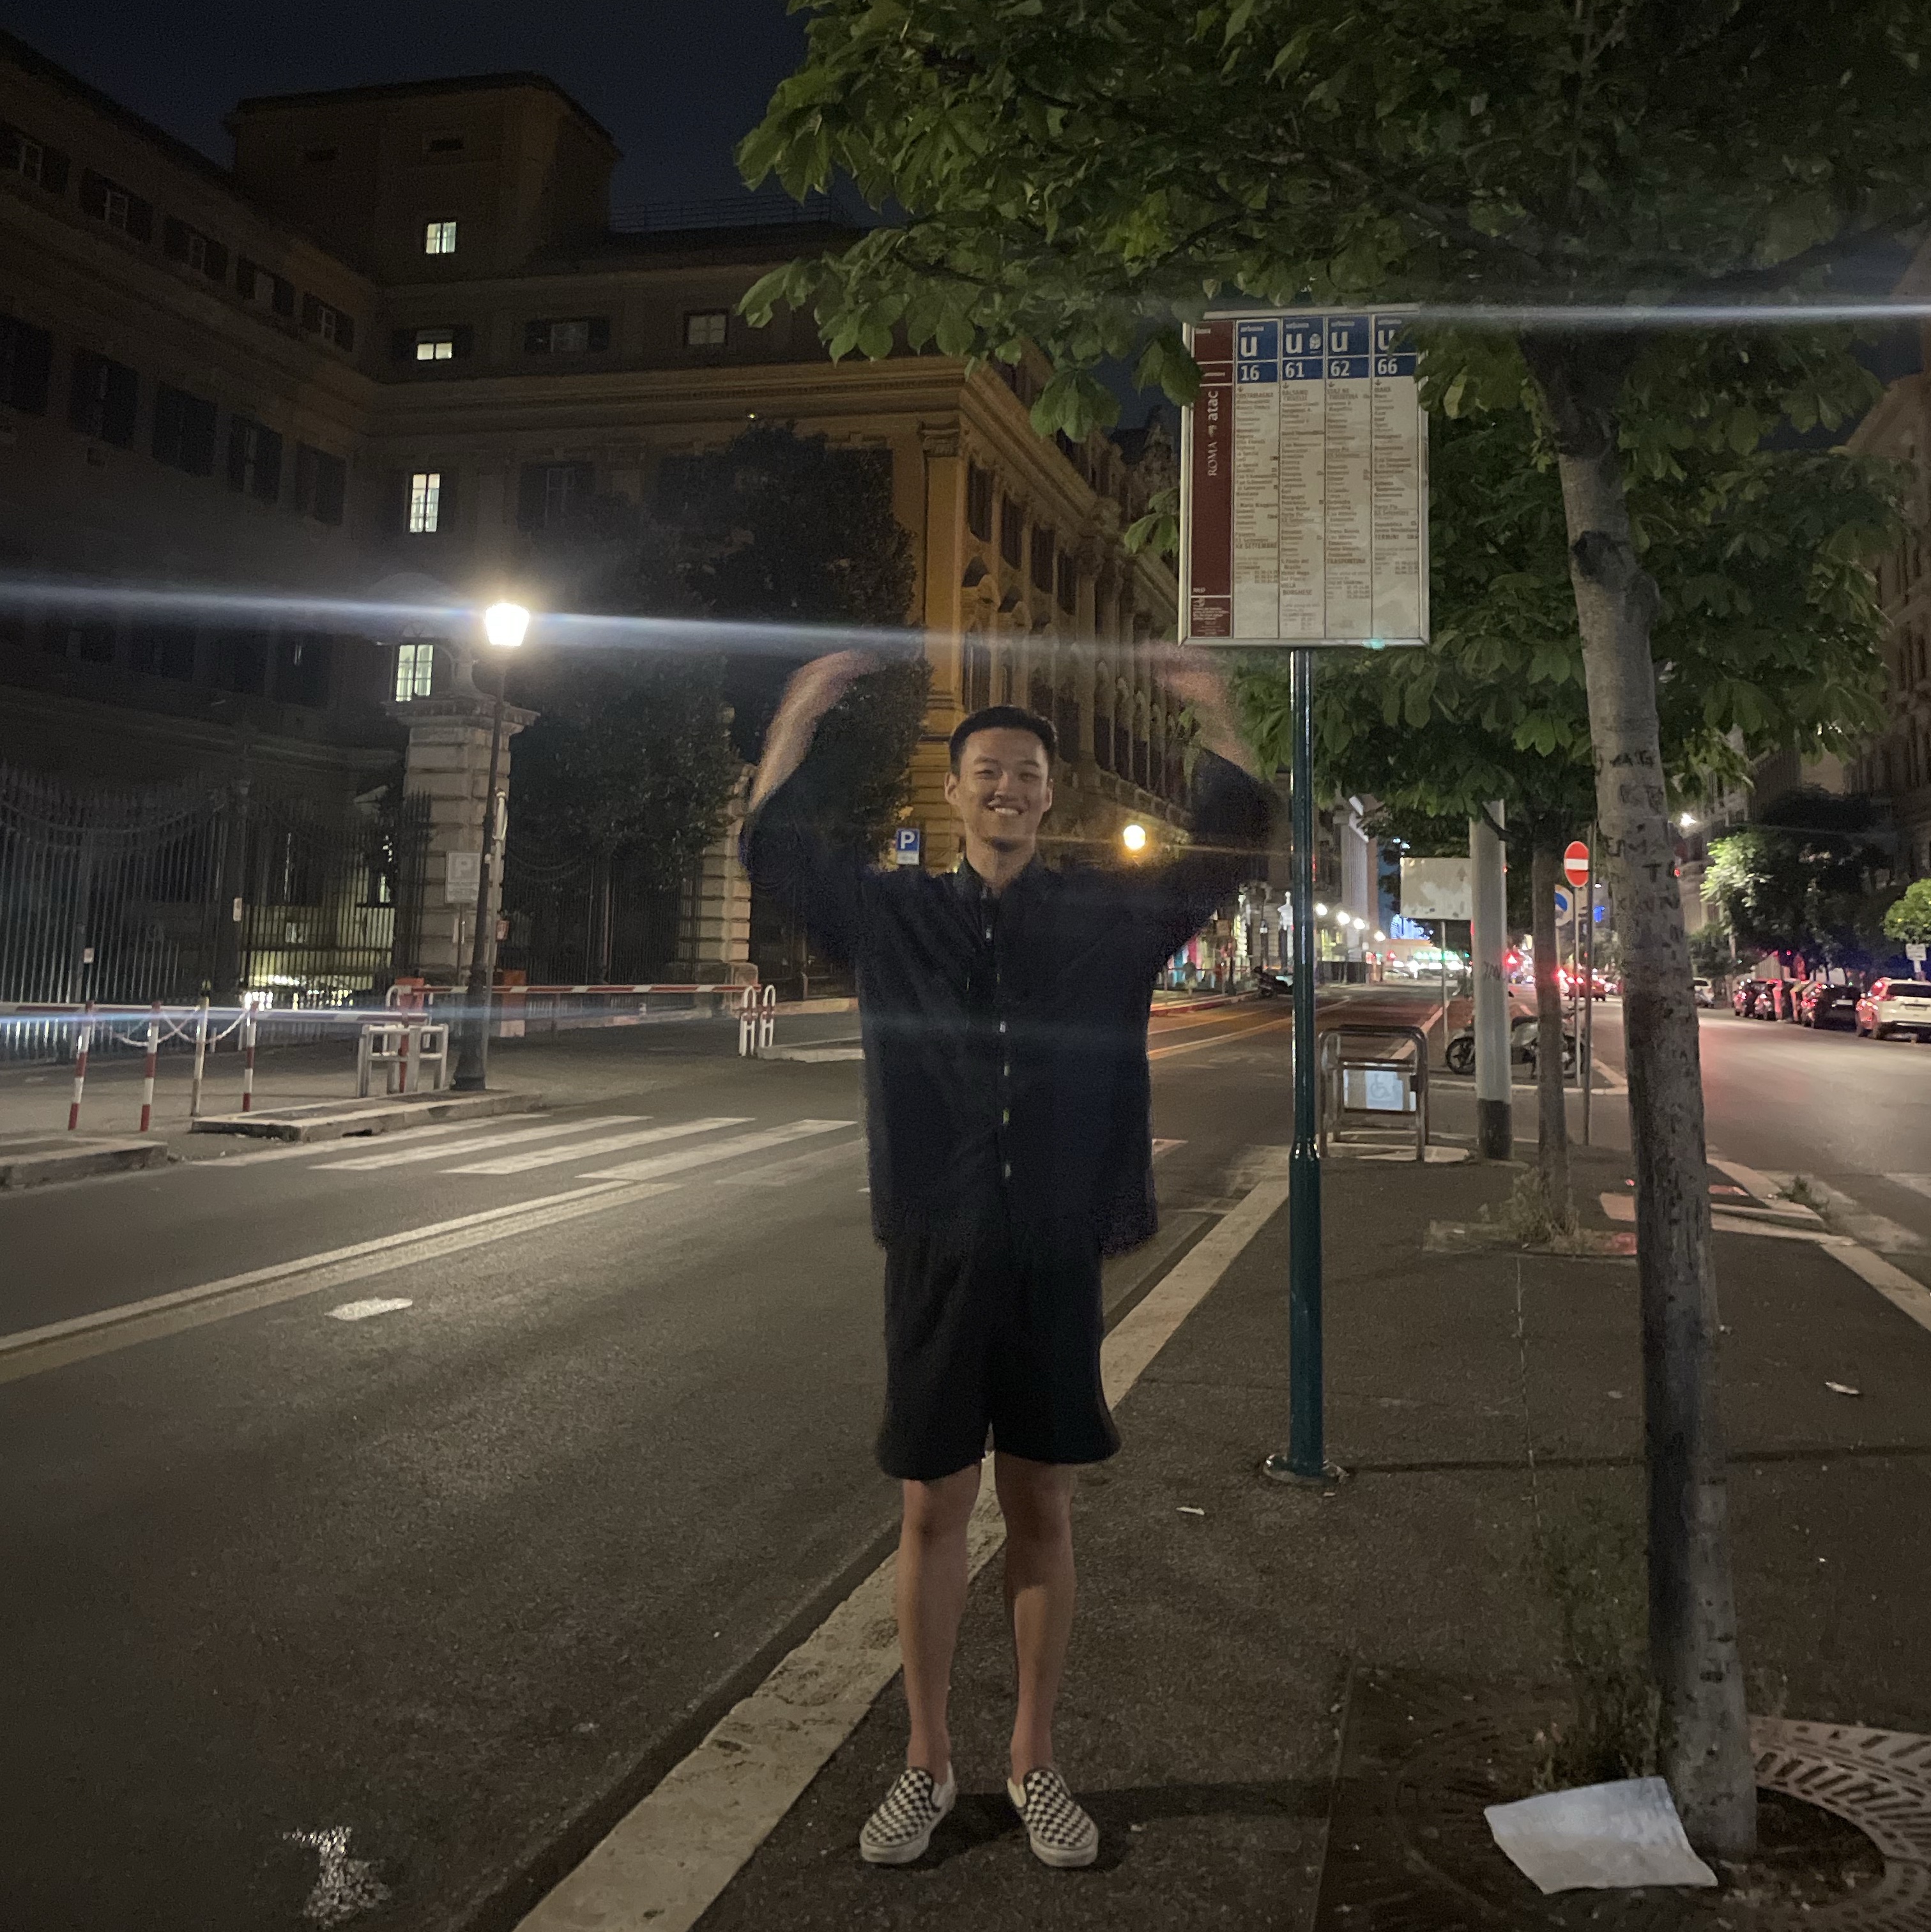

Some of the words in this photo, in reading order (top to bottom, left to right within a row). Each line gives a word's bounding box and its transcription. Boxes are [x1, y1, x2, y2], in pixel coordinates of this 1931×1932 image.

[1240, 365, 1260, 381] 16
[1285, 361, 1305, 378] 61
[1331, 360, 1350, 377] 62
[1377, 358, 1398, 375] 66
[1207, 391, 1219, 421] atac
[1207, 441, 1218, 476] ROMA
[900, 831, 915, 849] P
